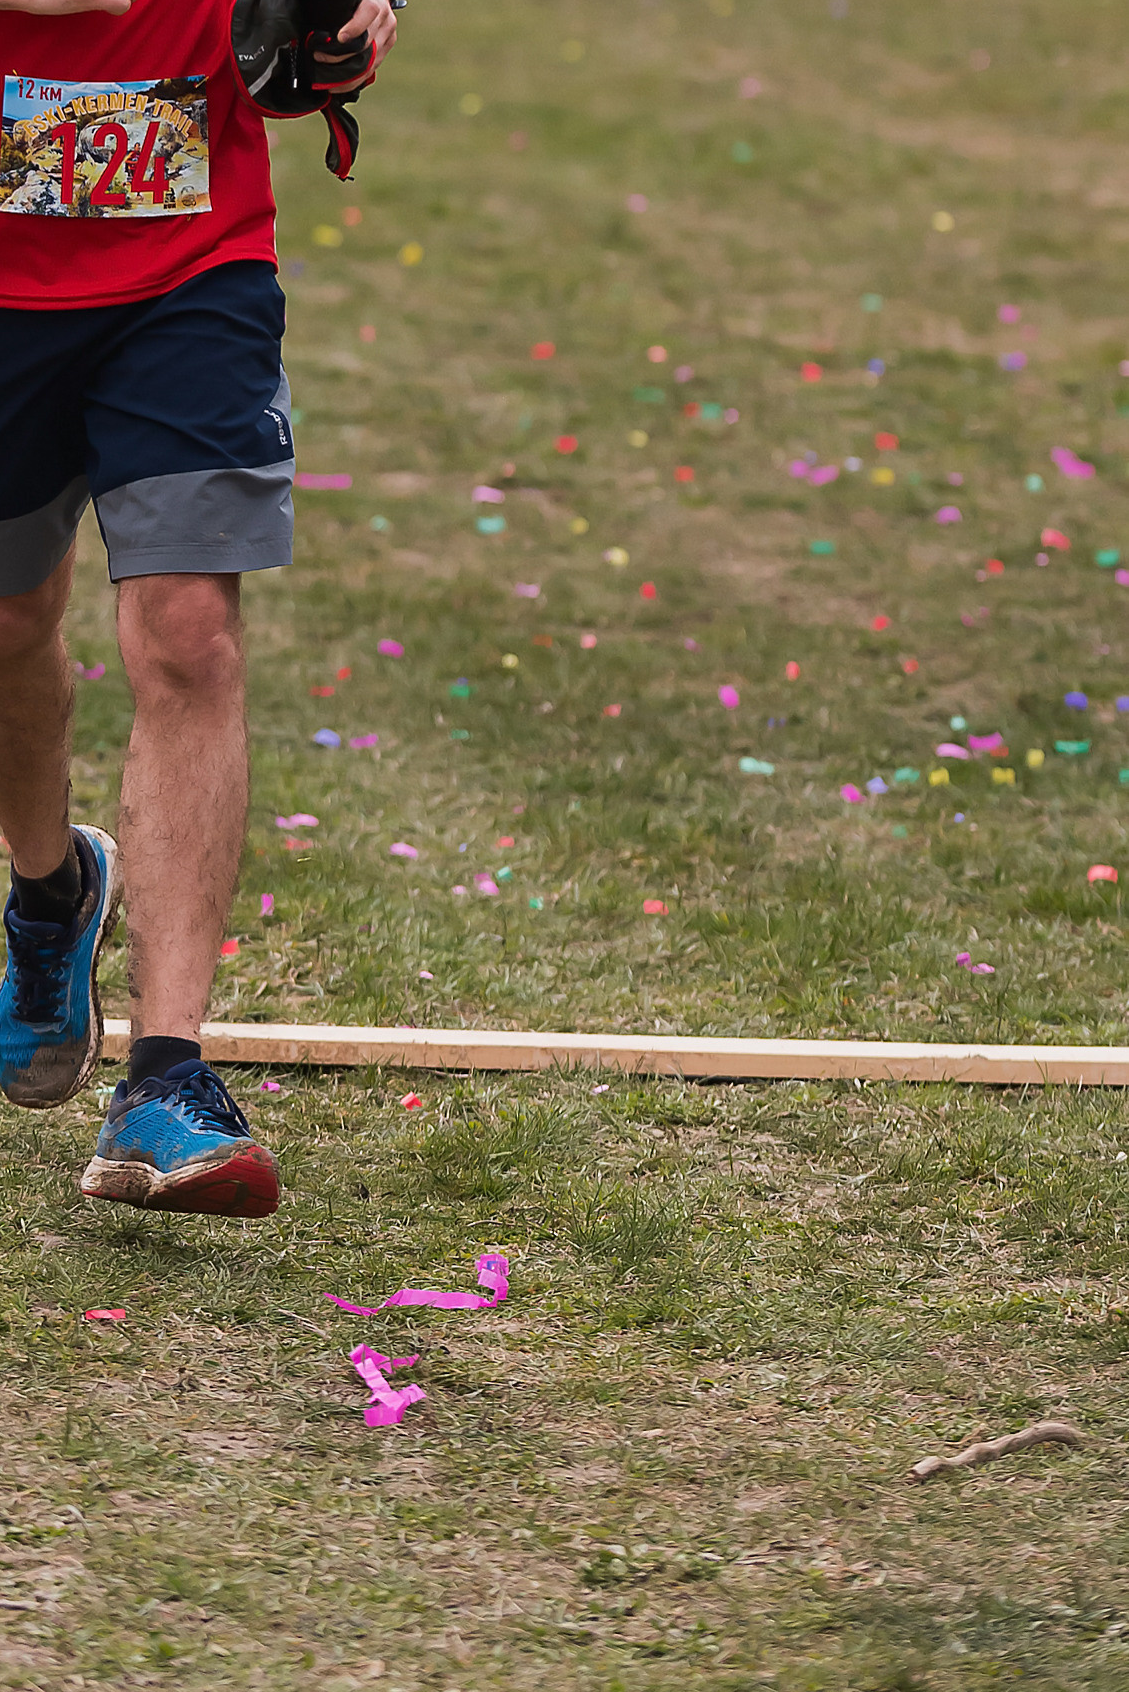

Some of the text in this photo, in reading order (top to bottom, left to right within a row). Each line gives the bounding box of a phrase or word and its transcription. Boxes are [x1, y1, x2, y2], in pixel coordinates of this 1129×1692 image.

[18, 78, 35, 99] 12
[23, 93, 193, 138] ESKI-KERMEN TRAIL
[52, 121, 170, 205] 124
